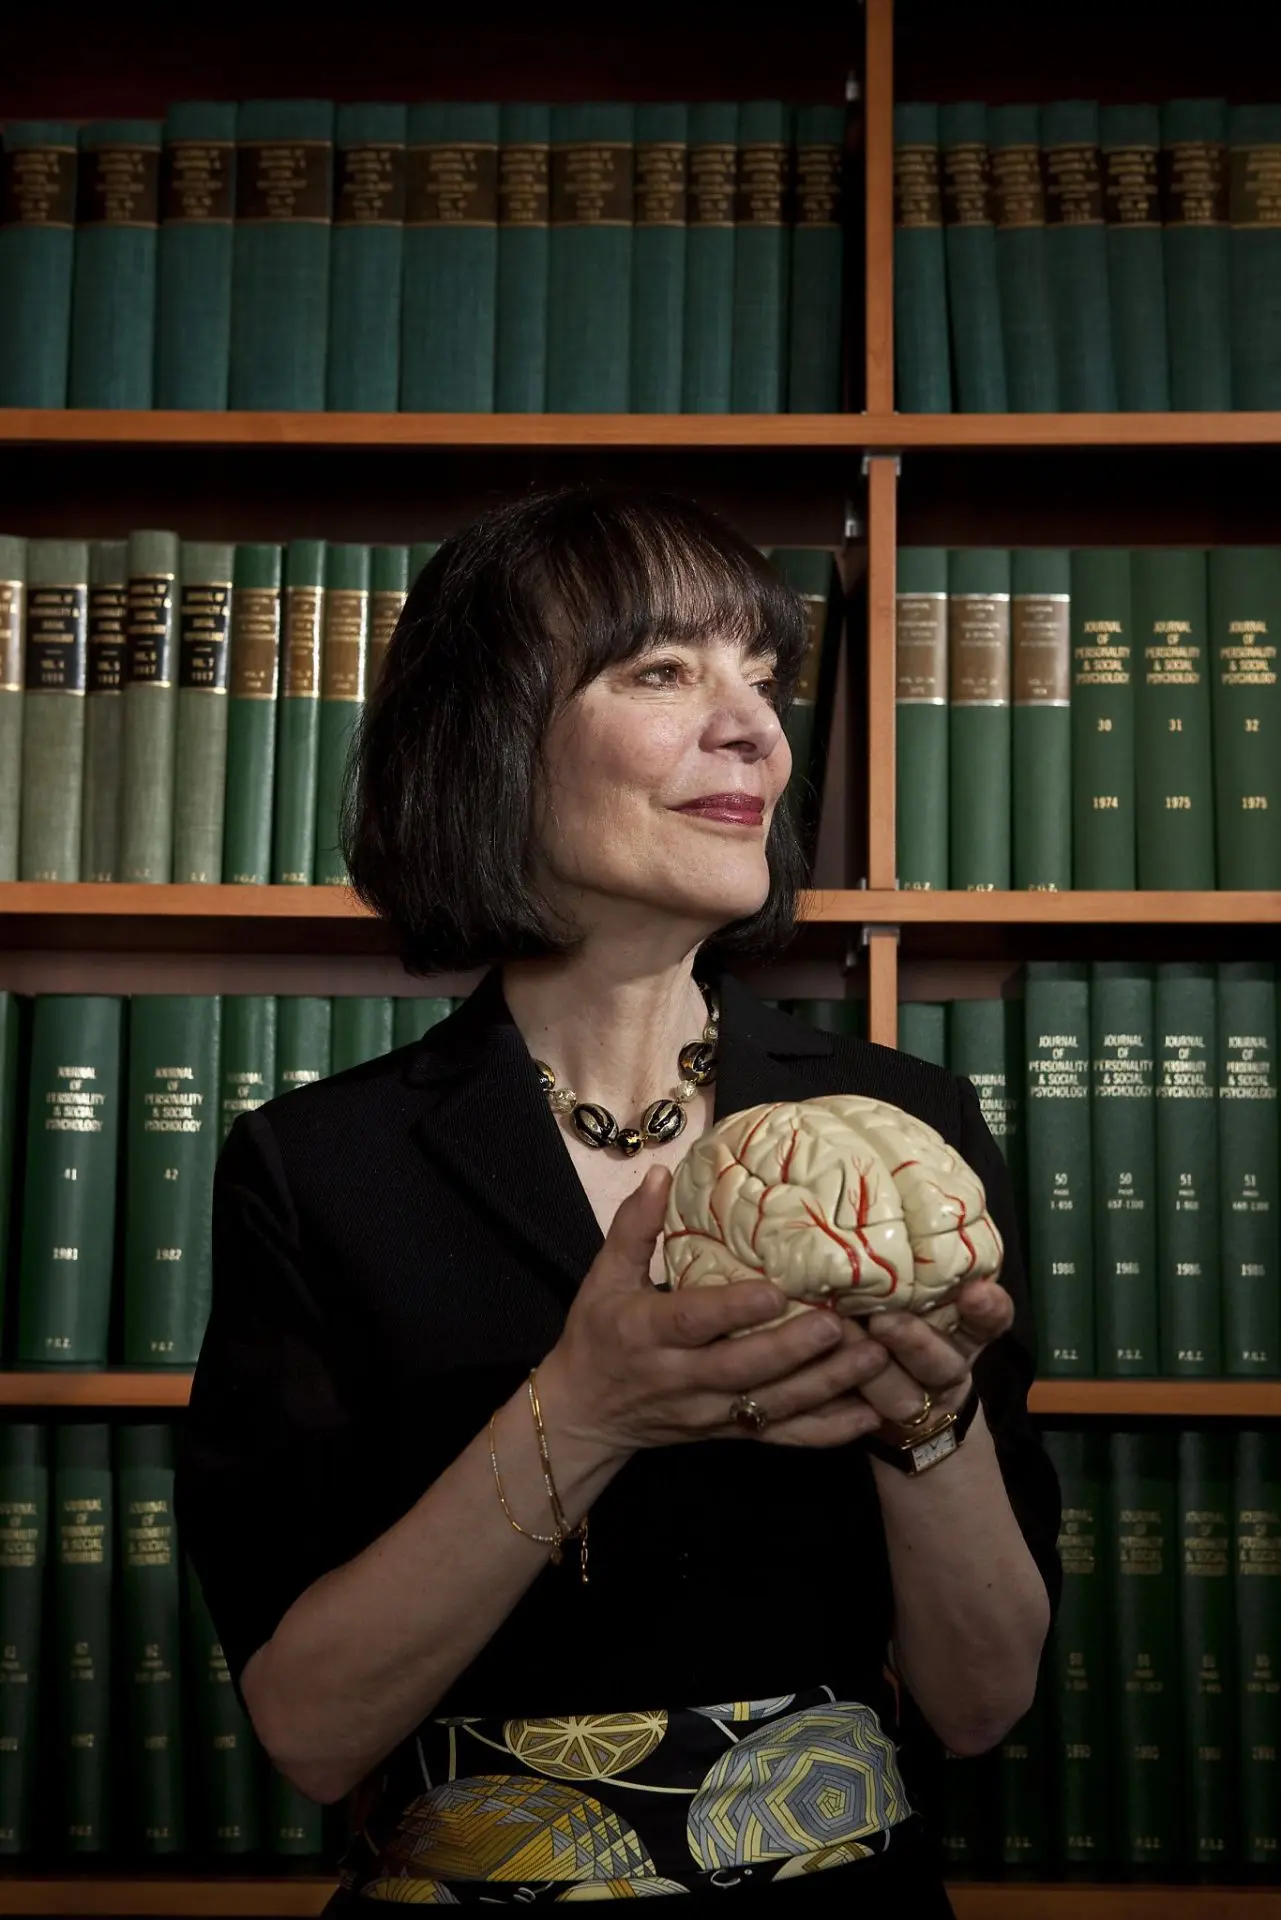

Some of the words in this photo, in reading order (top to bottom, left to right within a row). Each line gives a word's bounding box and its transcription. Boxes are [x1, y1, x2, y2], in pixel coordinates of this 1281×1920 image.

[1097, 633, 1109, 645] OF
[1167, 633, 1180, 645] OF
[1243, 633, 1255, 645] OF
[1093, 796, 1119, 810] 1974
[1165, 796, 1191, 810] 1975
[1242, 796, 1268, 811] 1975
[1039, 1035, 1079, 1048] JOURNAL
[1103, 1034, 1144, 1048] JOURNAL
[1164, 1035, 1206, 1048] JOURNAL
[1228, 1036, 1268, 1049] JOURNAL
[1052, 1048, 1065, 1060] OF
[1117, 1047, 1130, 1059] OF
[1178, 1048, 1190, 1060] OF
[1241, 1049, 1254, 1061] OF
[1028, 1060, 1089, 1073] PERSONALITY
[1093, 1060, 1153, 1073] PERSONALITY
[69, 1079, 83, 1091] OF
[1039, 1074, 1046, 1085] &
[1048, 1073, 1079, 1086] SOCIAL
[1103, 1072, 1111, 1084] &
[1113, 1072, 1144, 1085] SOCIAL
[1164, 1074, 1172, 1085] &
[1173, 1074, 1205, 1086] SOCIAL
[1228, 1074, 1236, 1086] &
[1237, 1075, 1269, 1087] SOCIAL
[167, 1080, 180, 1091] OF
[1029, 1086, 1088, 1098] PSYCHOLOGY
[1095, 1086, 1152, 1098] PSYCHOLOGY
[1156, 1086, 1214, 1099] PSYCHOLOGY
[1220, 1086, 1277, 1100] PSYCHOLOGY
[164, 1168, 179, 1181] 42
[1055, 1172, 1068, 1186] 50
[1120, 1172, 1133, 1186] 50
[1180, 1173, 1192, 1187] 51
[1244, 1174, 1256, 1187] 51
